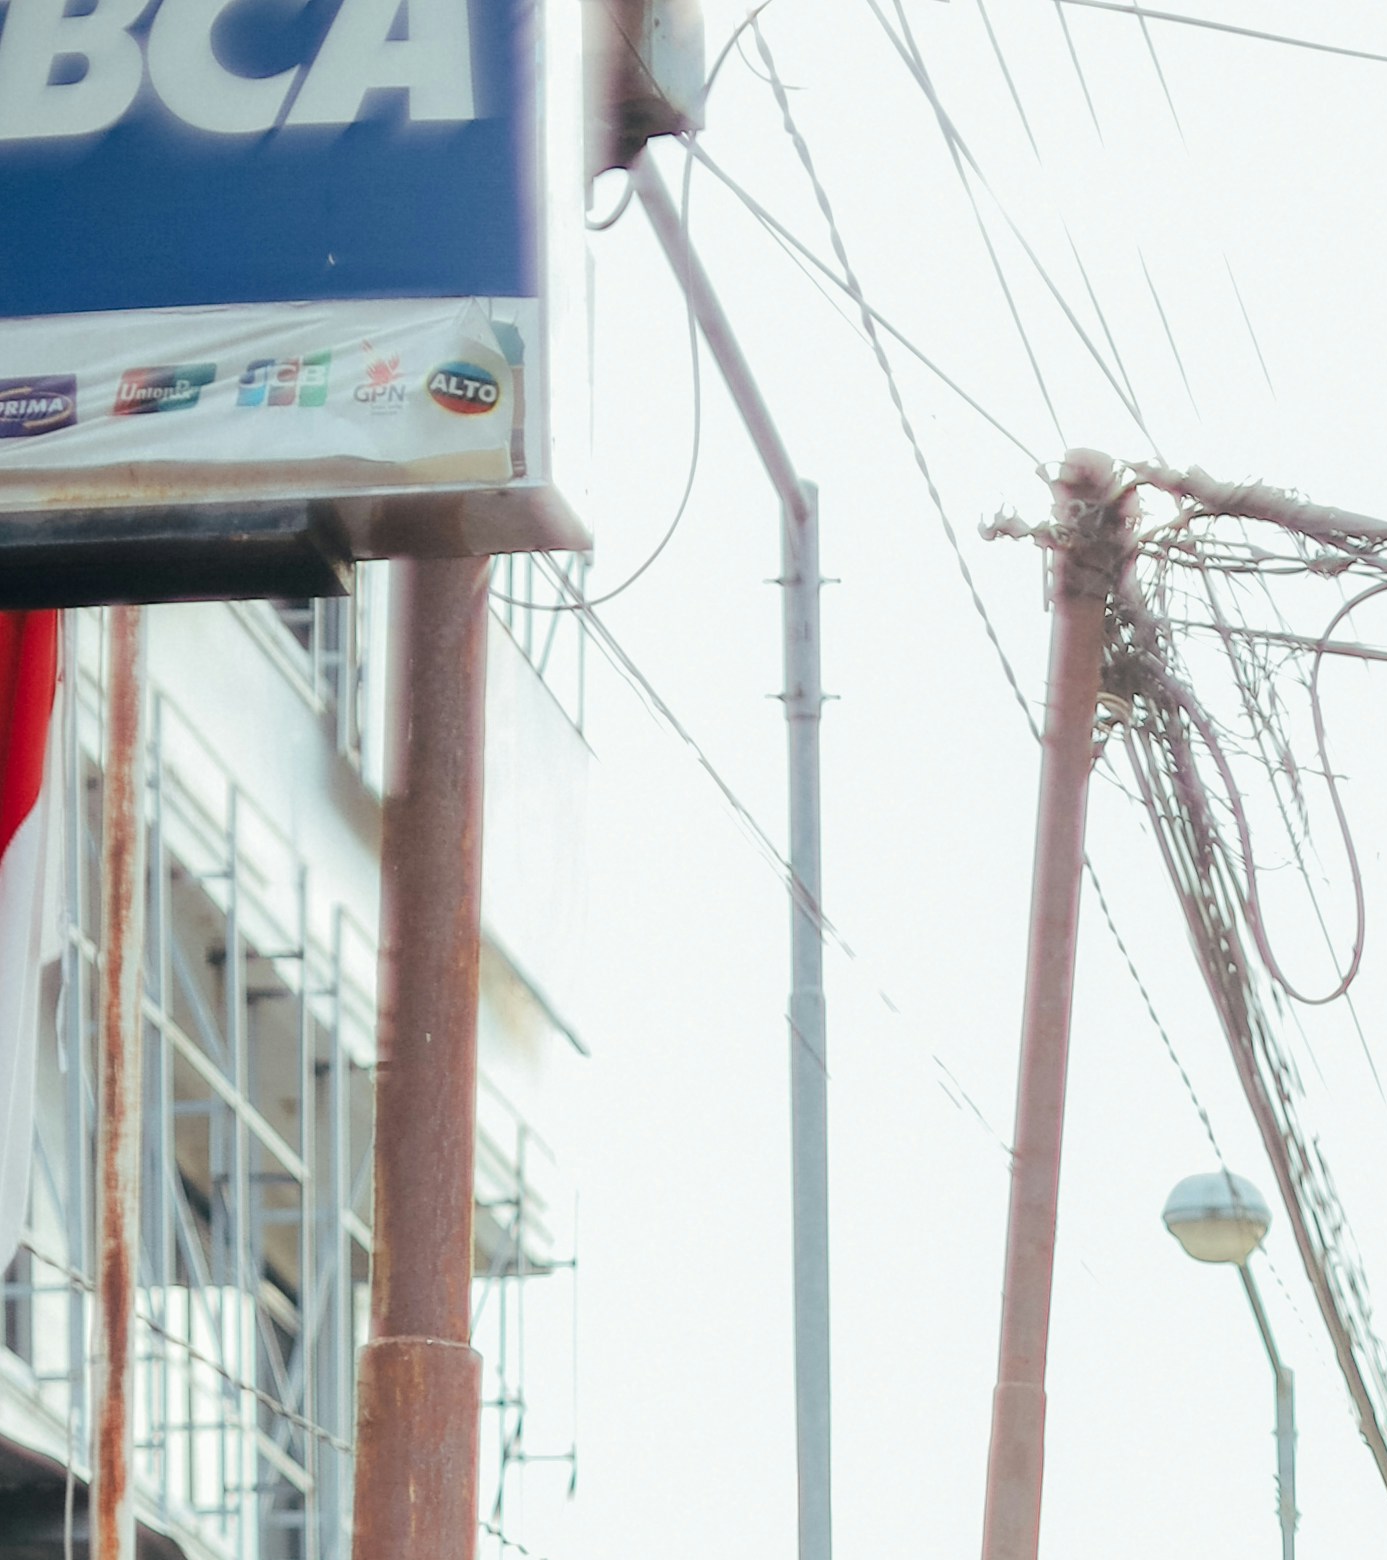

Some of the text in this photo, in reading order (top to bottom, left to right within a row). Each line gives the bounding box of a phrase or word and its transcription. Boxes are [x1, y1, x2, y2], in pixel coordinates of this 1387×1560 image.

[0, 0, 475, 138] BCA
[353, 383, 406, 404] GPN
[429, 372, 498, 403] ALTO
